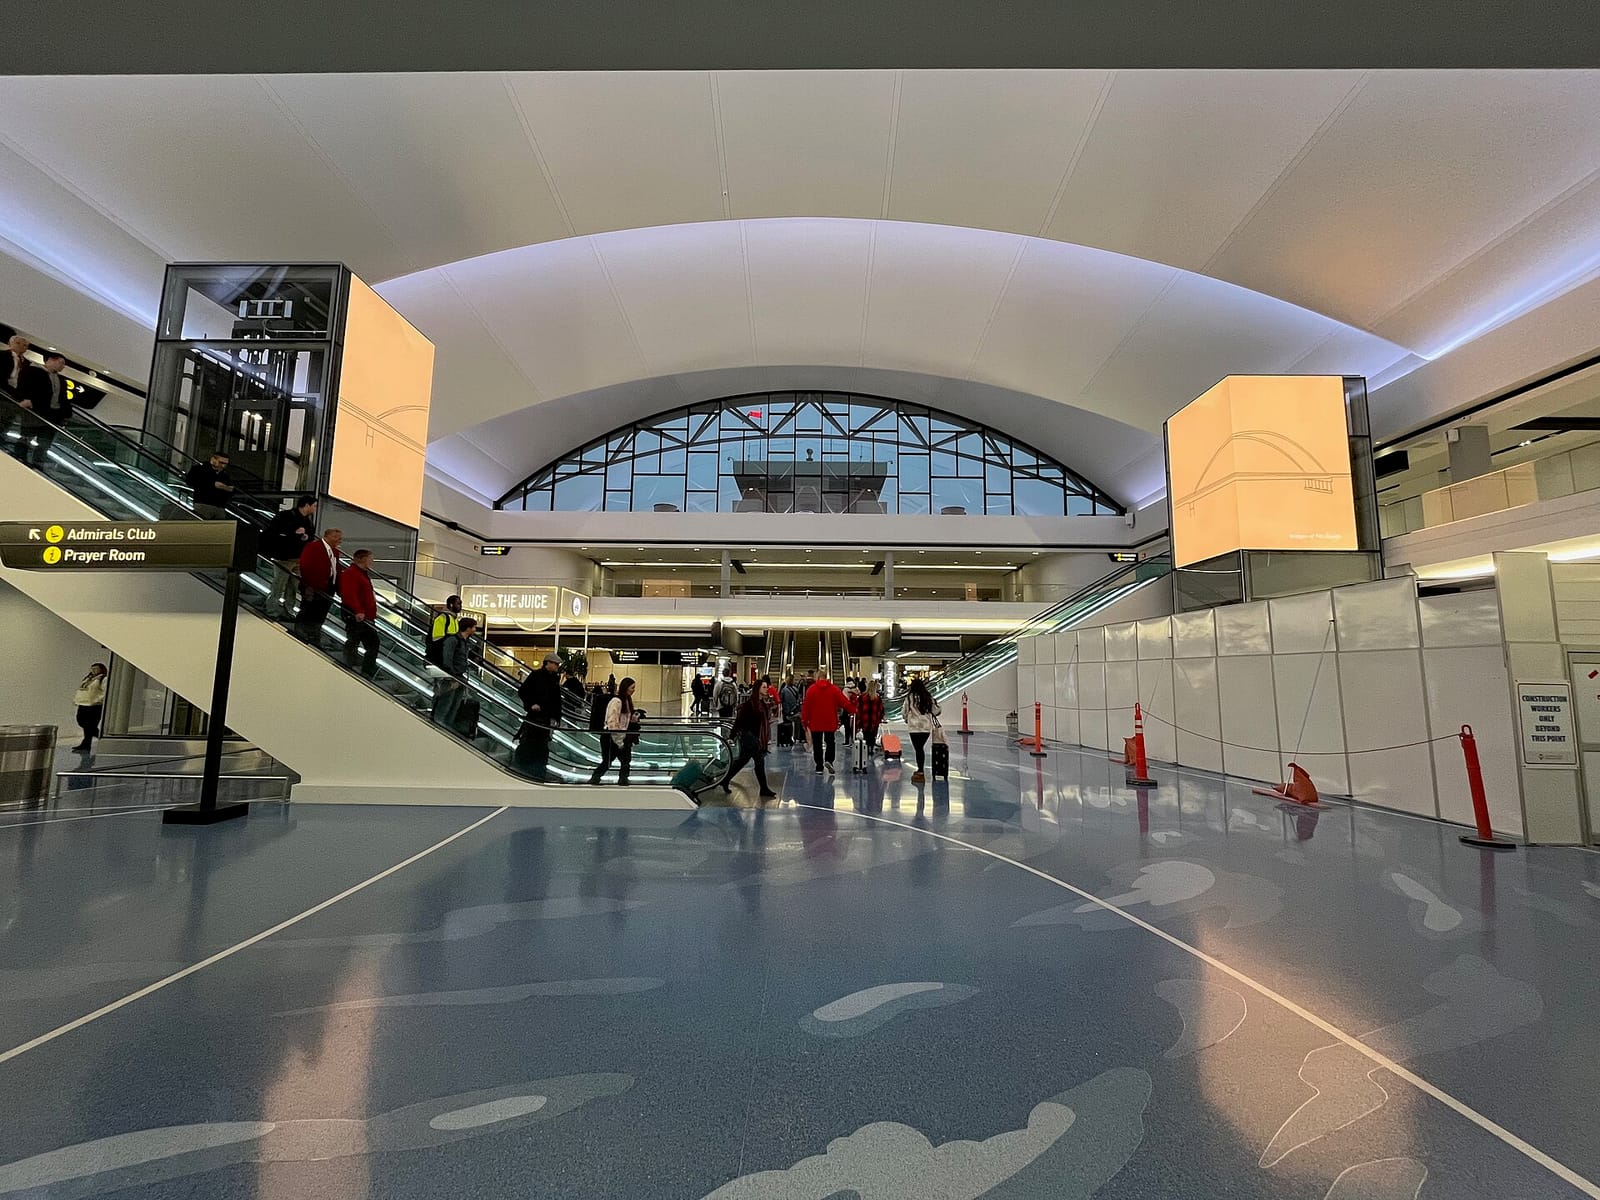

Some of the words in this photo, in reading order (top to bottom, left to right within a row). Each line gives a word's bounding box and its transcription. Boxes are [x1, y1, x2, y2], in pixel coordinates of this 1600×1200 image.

[67, 528, 124, 540] Admirals
[127, 528, 156, 540] Club
[64, 549, 107, 563] Prayer
[109, 549, 145, 561] Room
[469, 594, 488, 608] JOE
[497, 594, 517, 608] THE
[519, 594, 548, 608] JUICE
